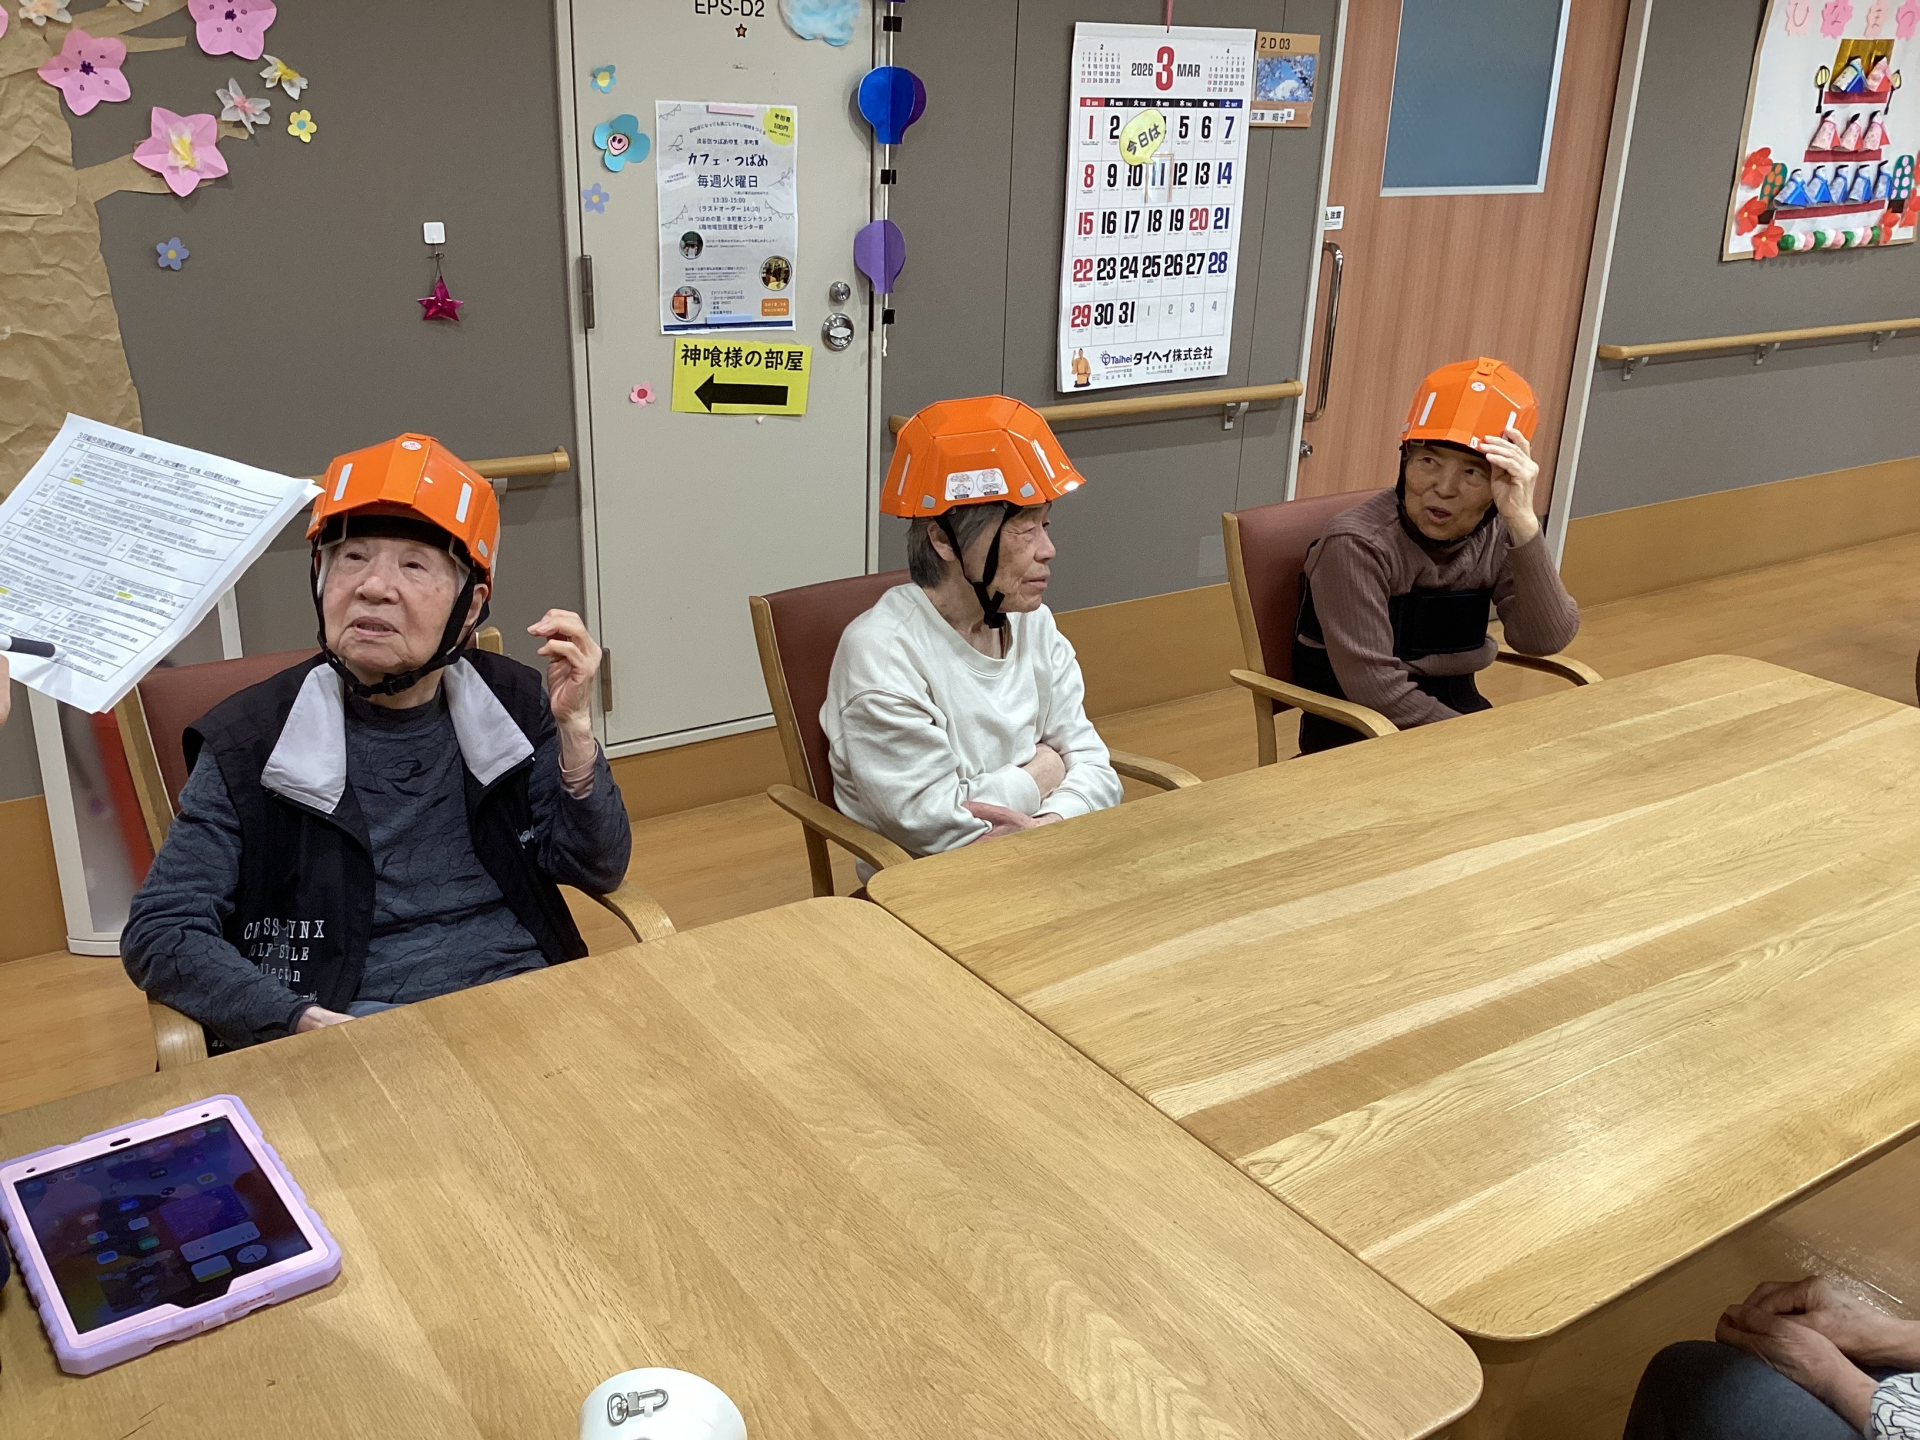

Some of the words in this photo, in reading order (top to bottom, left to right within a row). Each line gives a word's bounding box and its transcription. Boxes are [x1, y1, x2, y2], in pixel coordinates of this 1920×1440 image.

[695, 0, 764, 17] EPS-D2
[1261, 37, 1266, 48] 2
[1270, 38, 1276, 48] D
[1280, 38, 1290, 49] 03
[1132, 63, 1153, 76] 2026
[1156, 46, 1174, 91] 3
[1177, 64, 1200, 77] MAR
[1089, 116, 1093, 139] 1
[1110, 115, 1120, 139] 2
[1179, 116, 1190, 139] 5
[1202, 116, 1211, 139] 6
[1225, 116, 1234, 138] 7
[1127, 124, 1161, 155] 今日は
[688, 153, 768, 167] カフェ・つばめ
[697, 175, 758, 188] 毎週火曜日
[1084, 164, 1094, 188] 8
[1107, 164, 1117, 187] 9
[1128, 164, 1142, 186] 10
[1152, 163, 1165, 186] 11
[1173, 163, 1187, 185] 12
[1195, 162, 1210, 185] 13
[1218, 162, 1232, 184] 14
[1078, 212, 1094, 235] 15
[1102, 211, 1117, 234] 16
[1125, 211, 1140, 233] 17
[1147, 209, 1162, 232] 18
[1169, 209, 1184, 231] 19
[1189, 208, 1209, 231] 20
[1214, 207, 1230, 229] 21
[1073, 259, 1093, 282] 22
[1097, 258, 1116, 280] 23
[1120, 256, 1138, 279] 24
[1142, 255, 1161, 277] 25
[1164, 254, 1183, 276] 26
[1186, 253, 1205, 275] 27
[1208, 252, 1228, 273] 28
[1071, 305, 1091, 327] 29
[1094, 303, 1113, 325] 30
[1119, 302, 1135, 323] 31
[1147, 306, 1150, 316] 1
[1168, 304, 1173, 314] 2
[1190, 303, 1195, 313] 3
[1212, 301, 1217, 311] 4
[681, 343, 804, 371] 神喰様の部屋
[1111, 355, 1132, 365] Taihei
[1133, 346, 1213, 365] タイヘイ株式会社
